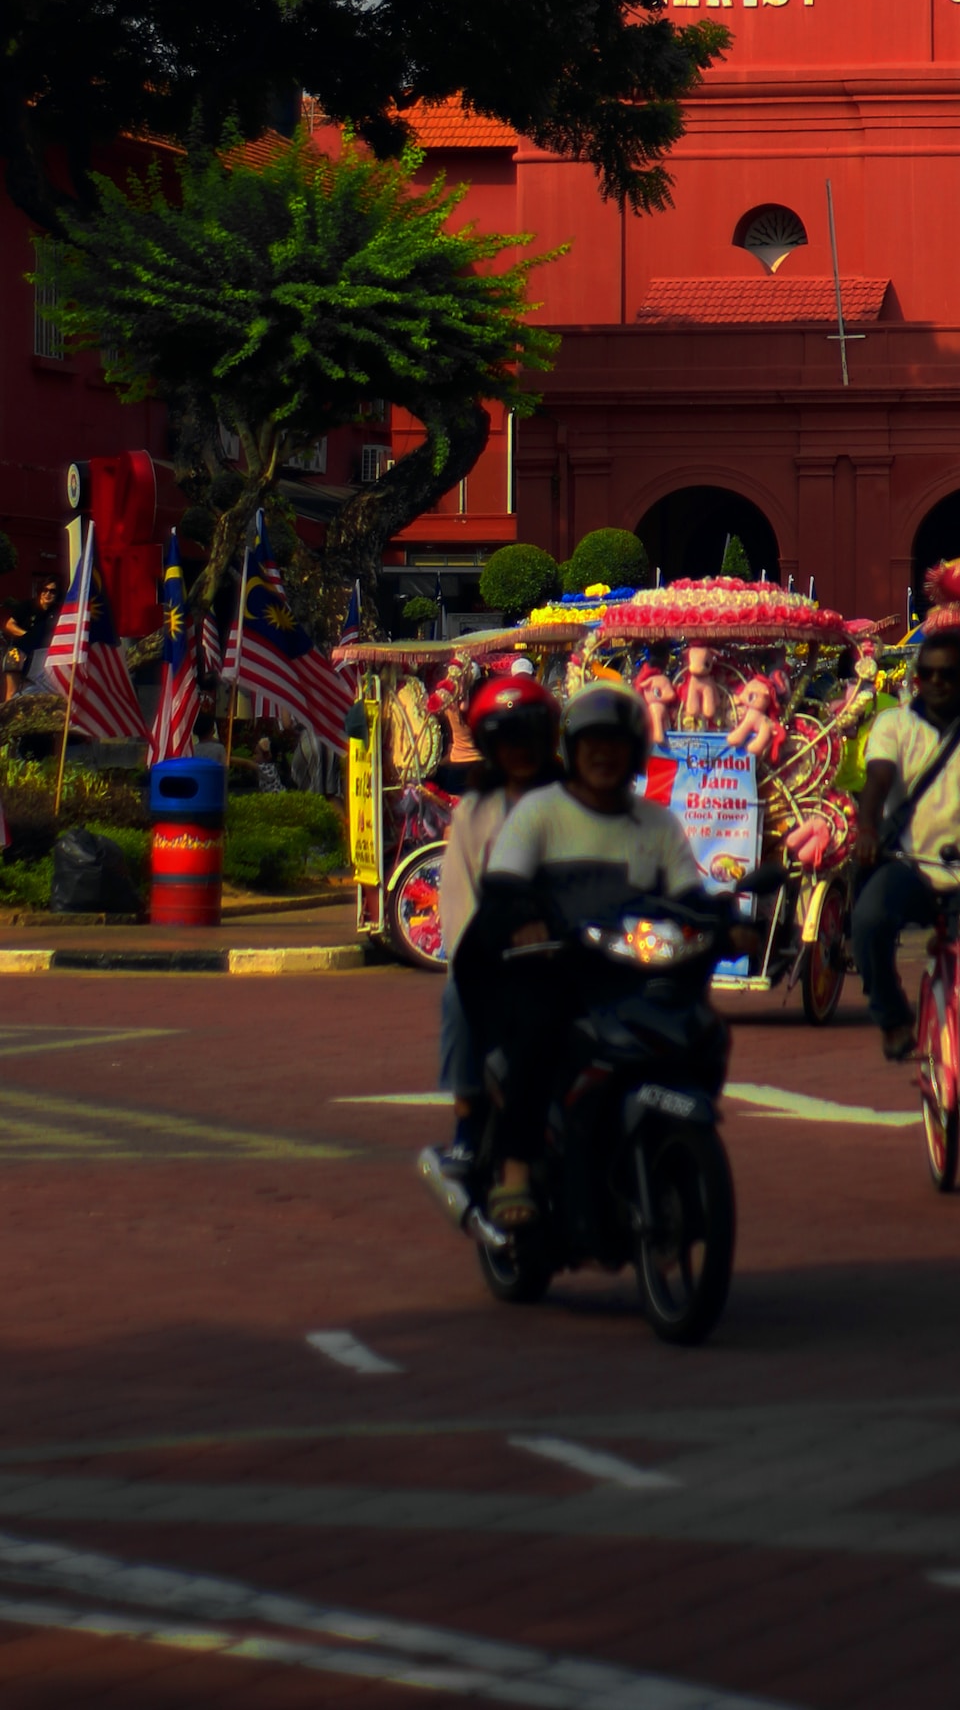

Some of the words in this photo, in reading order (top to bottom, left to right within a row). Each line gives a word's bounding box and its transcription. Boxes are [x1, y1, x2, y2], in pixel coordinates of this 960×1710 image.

[698, 774, 738, 790] Jam
[686, 792, 748, 810] Besau
[684, 811, 713, 821] (Clock
[716, 811, 750, 822] Tower)
